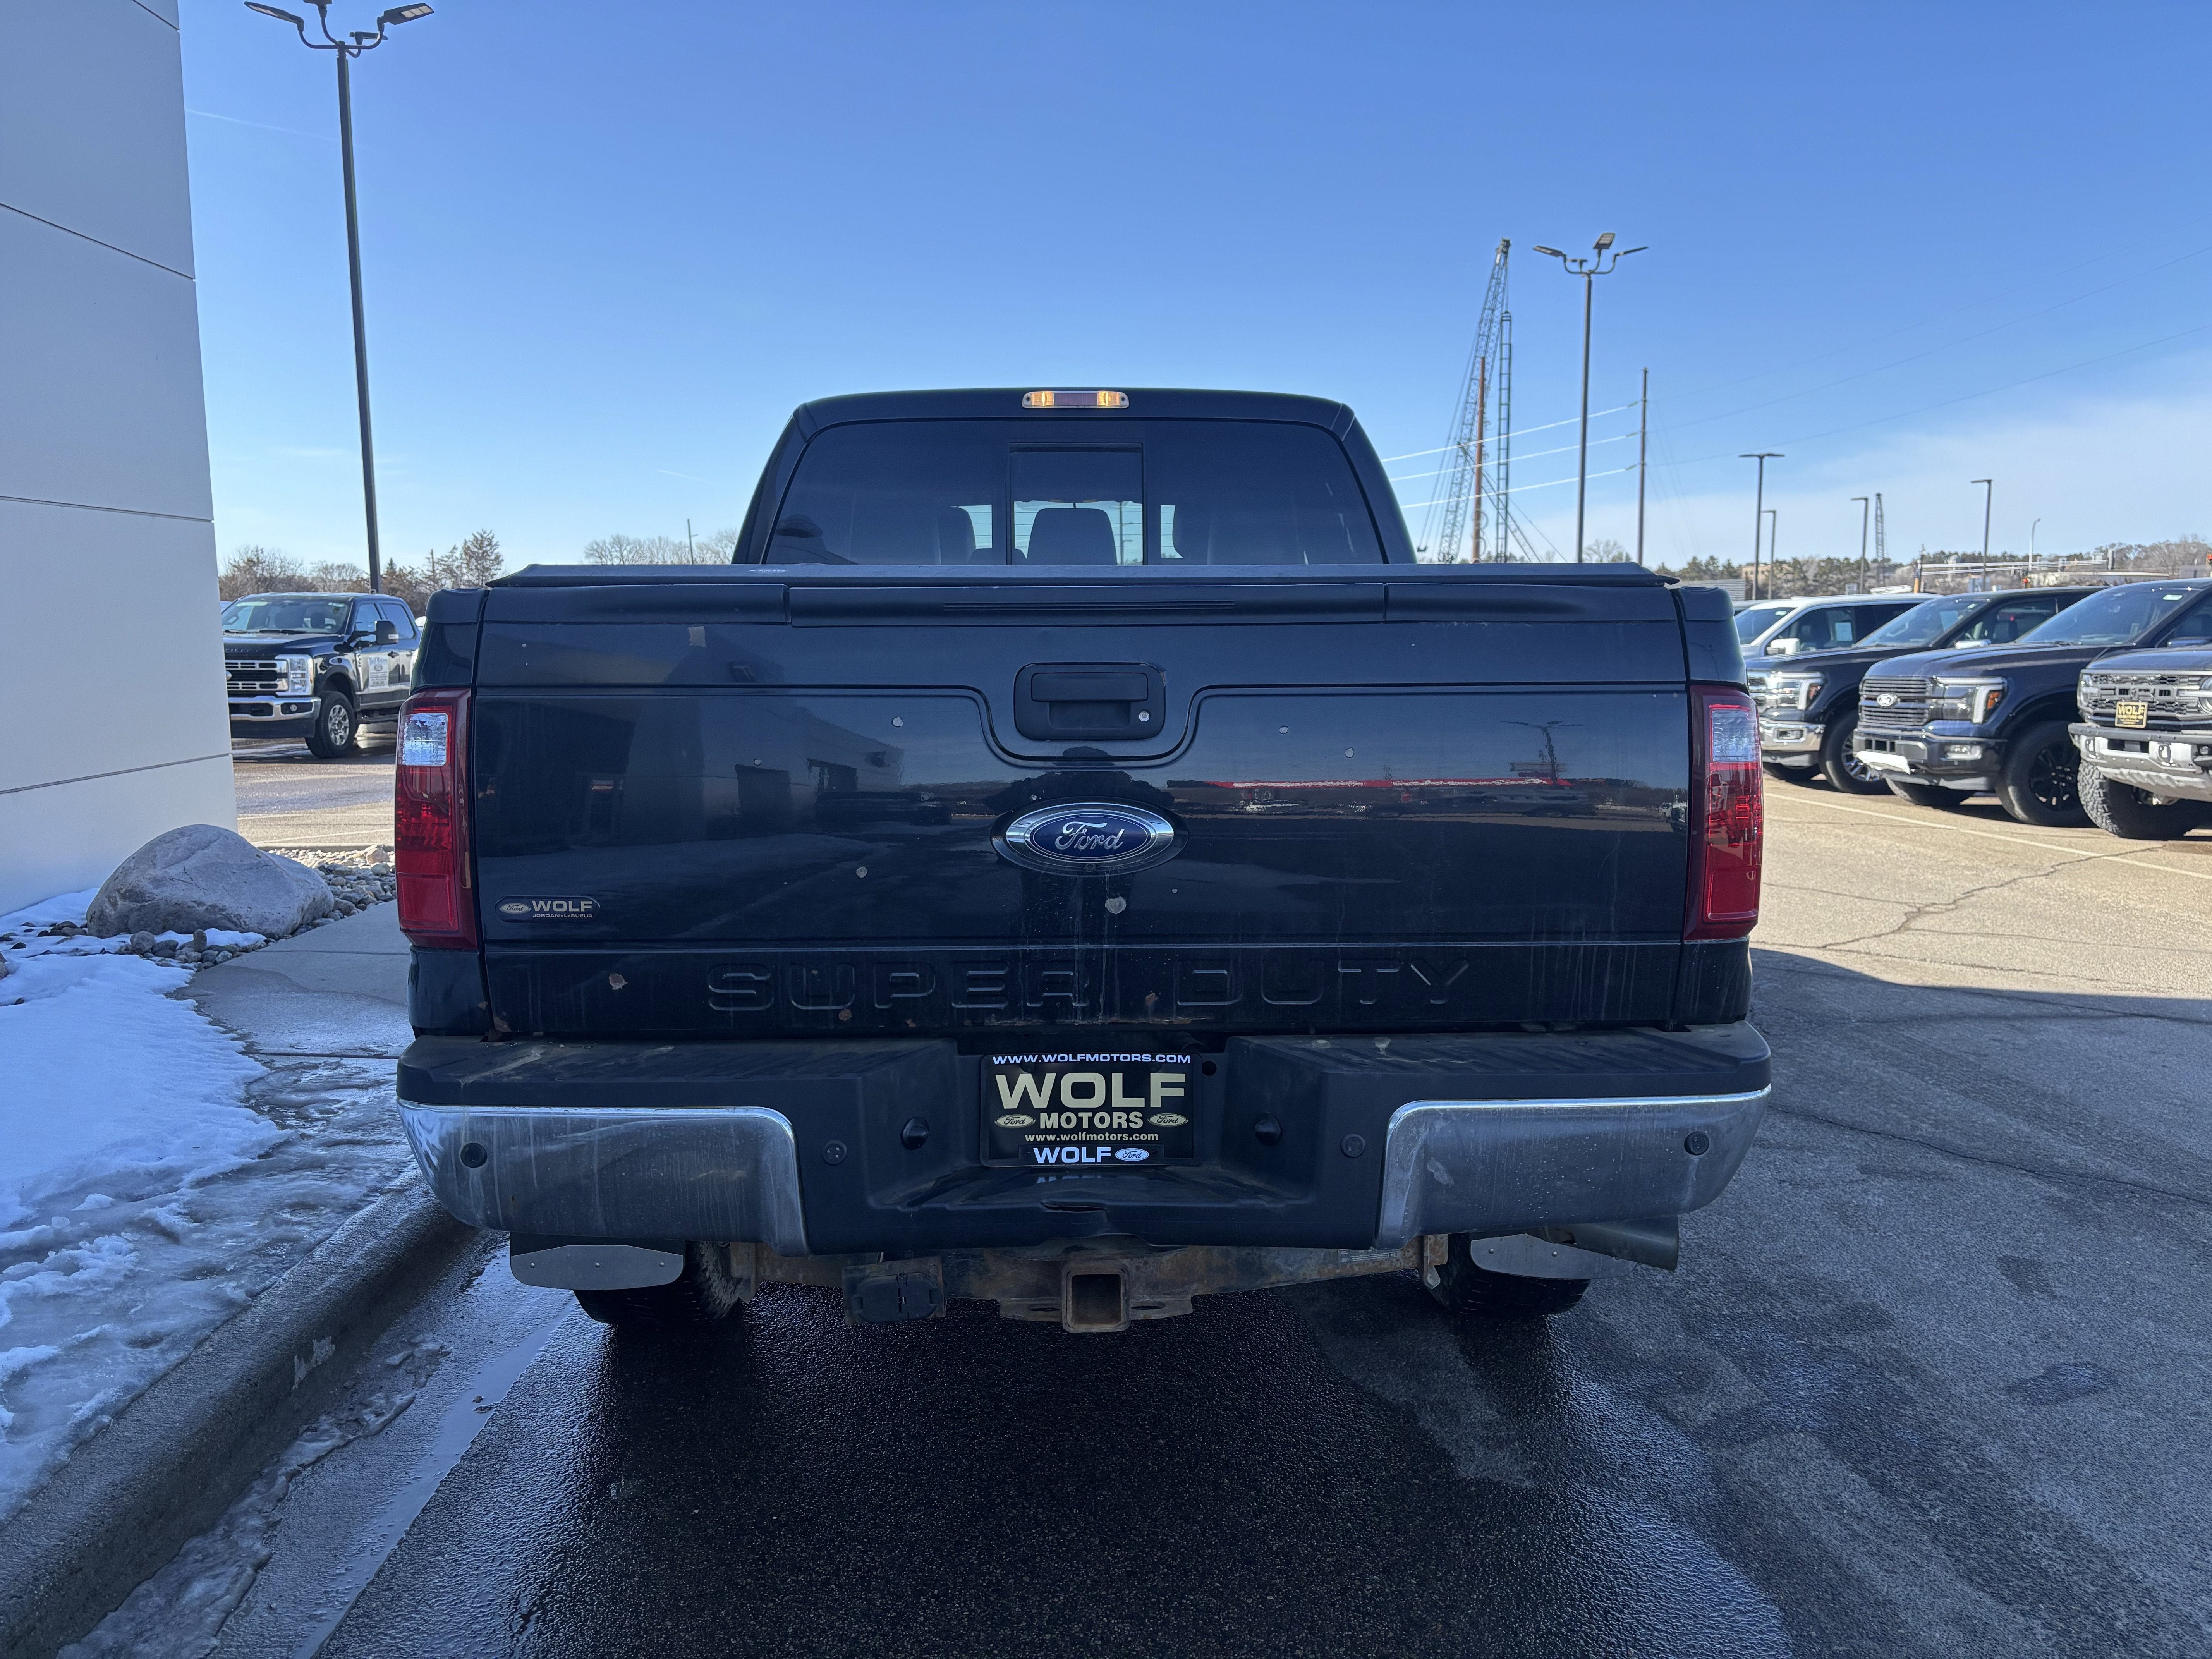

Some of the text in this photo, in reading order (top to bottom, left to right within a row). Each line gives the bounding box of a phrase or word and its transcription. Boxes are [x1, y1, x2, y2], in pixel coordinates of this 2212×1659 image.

[1055, 821, 1125, 850] Ford
[532, 901, 592, 912] WOLF
[708, 958, 1470, 1010] SUPER DUTY
[992, 1054, 1191, 1065] WWW.WOLFMOTORS.COM
[995, 1072, 1186, 1109] WOLF
[1004, 1112, 1179, 1129] Ford MOTORS Ford
[1025, 1132, 1159, 1141] www.wolfmotors.com
[1033, 1147, 1142, 1163] WOLF Ford
